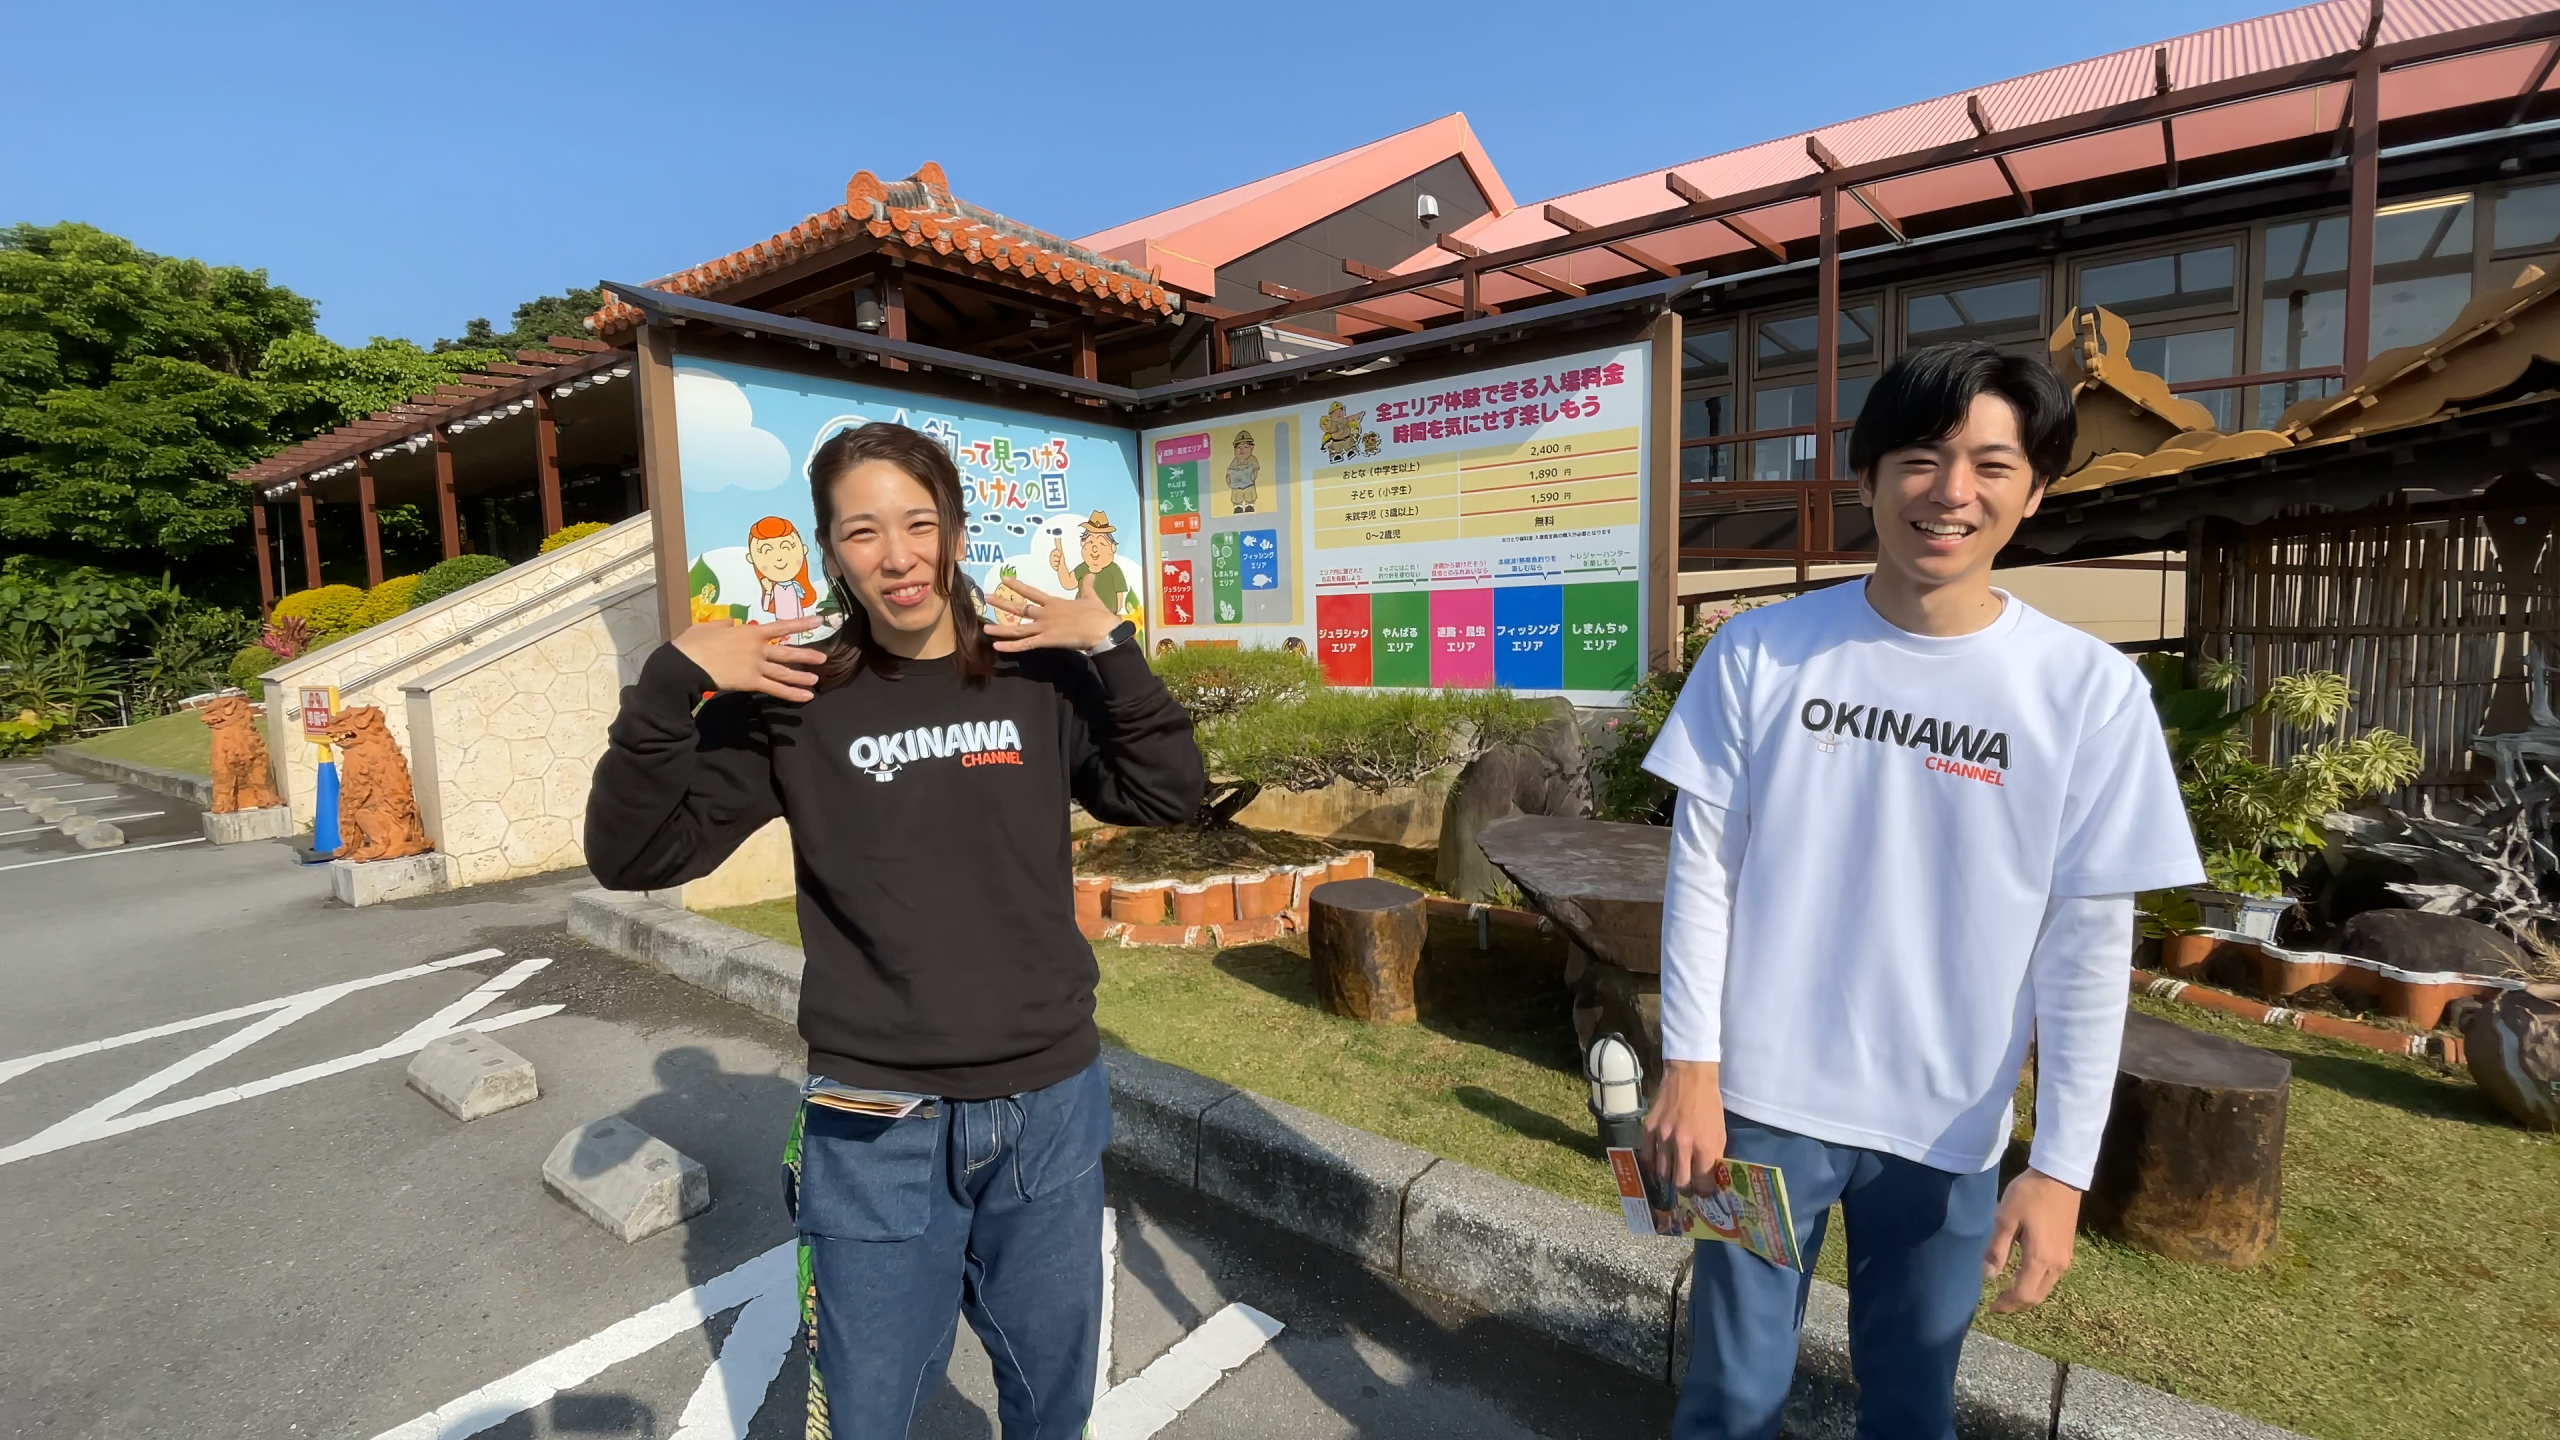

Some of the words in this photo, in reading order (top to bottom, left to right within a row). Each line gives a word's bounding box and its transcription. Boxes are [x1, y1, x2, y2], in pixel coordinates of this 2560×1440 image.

[1376, 362, 1625, 422] 全エリア体験できる入場料金
[1393, 395, 1601, 444] 時間を気にせず楽しもう
[1530, 444, 1560, 456] 2,400
[1564, 445, 1572, 453] 円
[1529, 468, 1558, 480] 1,890
[1564, 468, 1572, 476] 円
[957, 470, 1068, 509] うけんの国
[1170, 490, 1185, 498] エリア
[1531, 492, 1560, 504] 1,590
[1564, 492, 1572, 500] 円
[1534, 515, 1555, 527] 無料
[1242, 551, 1275, 561] フィッシング
[1569, 550, 1631, 560] トレジャーハンター
[1163, 585, 1191, 593] ジュラシック
[1219, 579, 1234, 587] エリア
[1318, 627, 1369, 640] ジュラシック
[1382, 627, 1418, 638] やんばる
[1436, 625, 1486, 638] 迷路・昆虫
[1496, 623, 1561, 637] フィッシング
[1572, 622, 1629, 635] しまんちゅ
[1331, 643, 1357, 653] エリア
[1387, 642, 1414, 653] エリア
[1446, 642, 1476, 653] エリア
[1511, 640, 1544, 652] エリア
[1583, 640, 1617, 651] エリア
[1801, 698, 2012, 770] OKINAWA
[849, 719, 1023, 769] OKINAWA
[961, 750, 1024, 768] CHANNEL
[1925, 756, 2004, 787] CHANNEL
